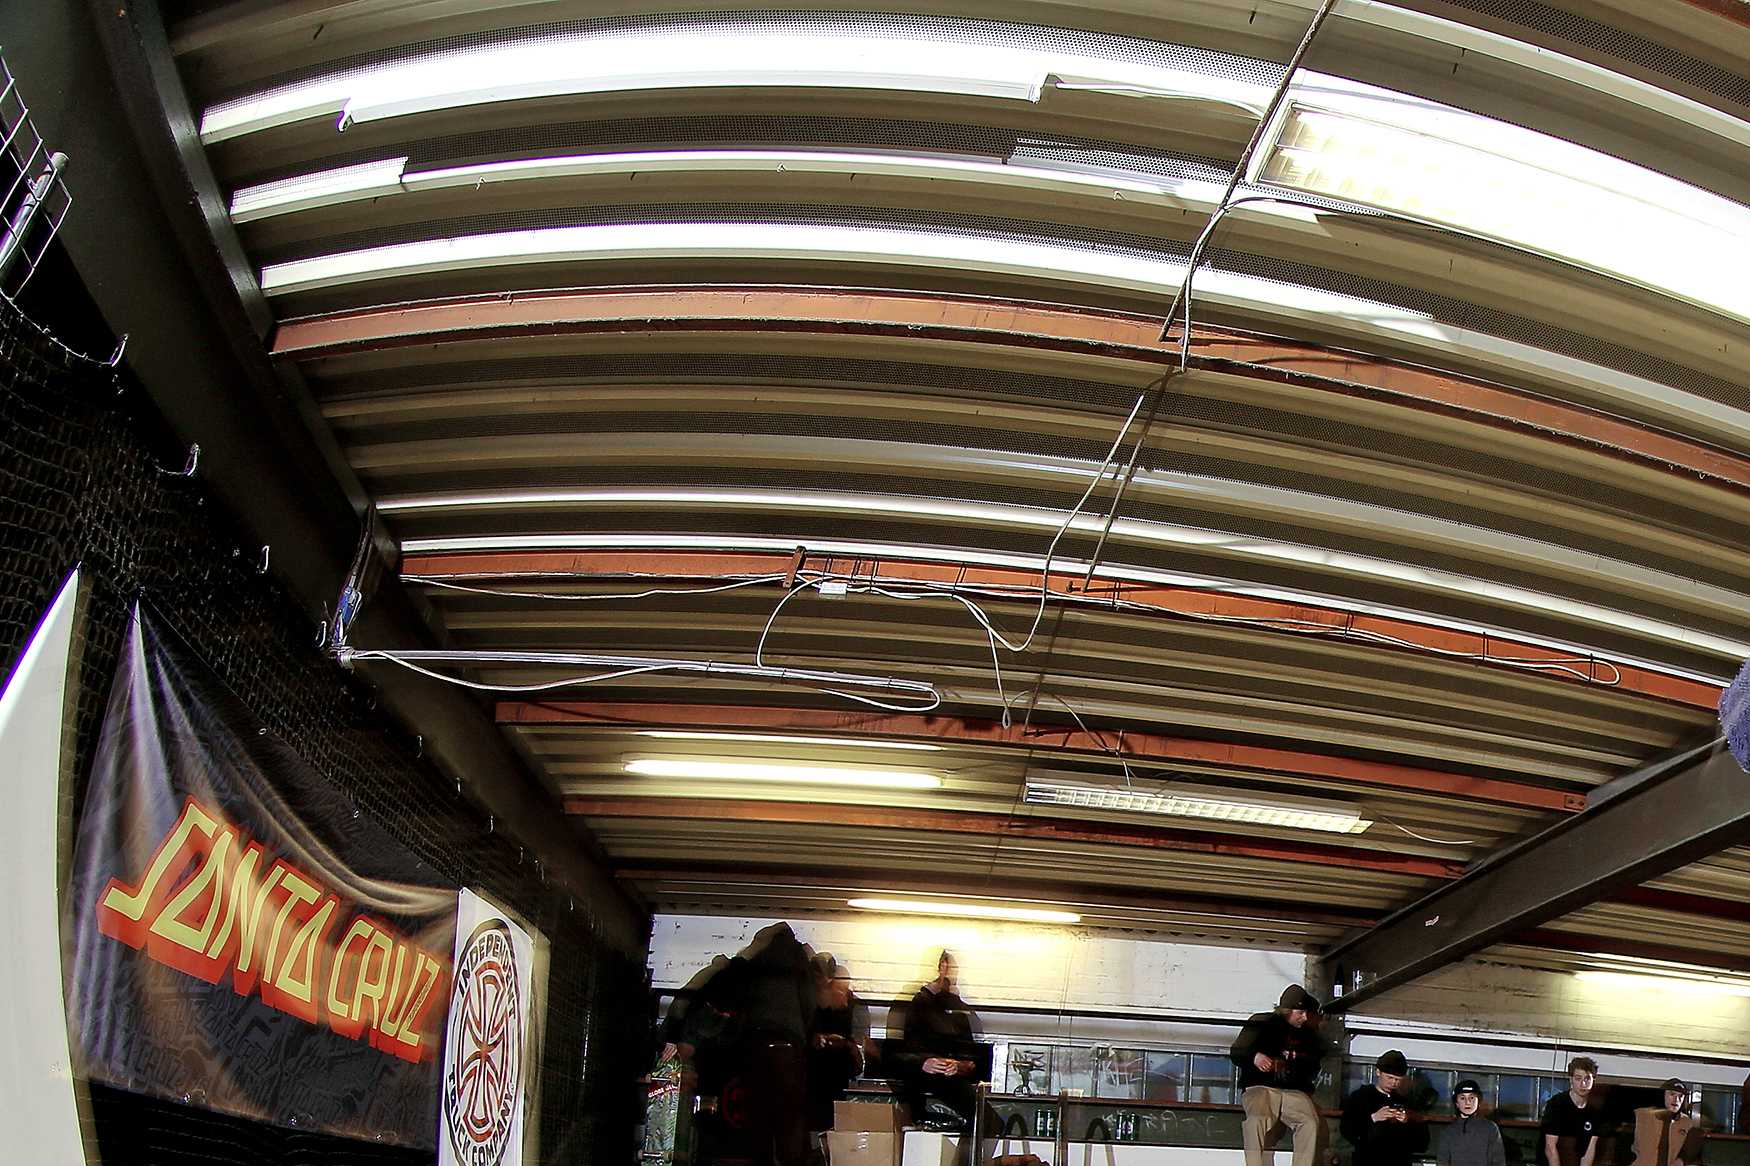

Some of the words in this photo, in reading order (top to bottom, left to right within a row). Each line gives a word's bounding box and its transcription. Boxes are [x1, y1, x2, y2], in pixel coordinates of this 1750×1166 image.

[99, 801, 323, 1010] SANTA
[327, 917, 443, 1050] CRUZ
[458, 933, 516, 1020] INDEPENDENT
[449, 1063, 470, 1162] TRUCK
